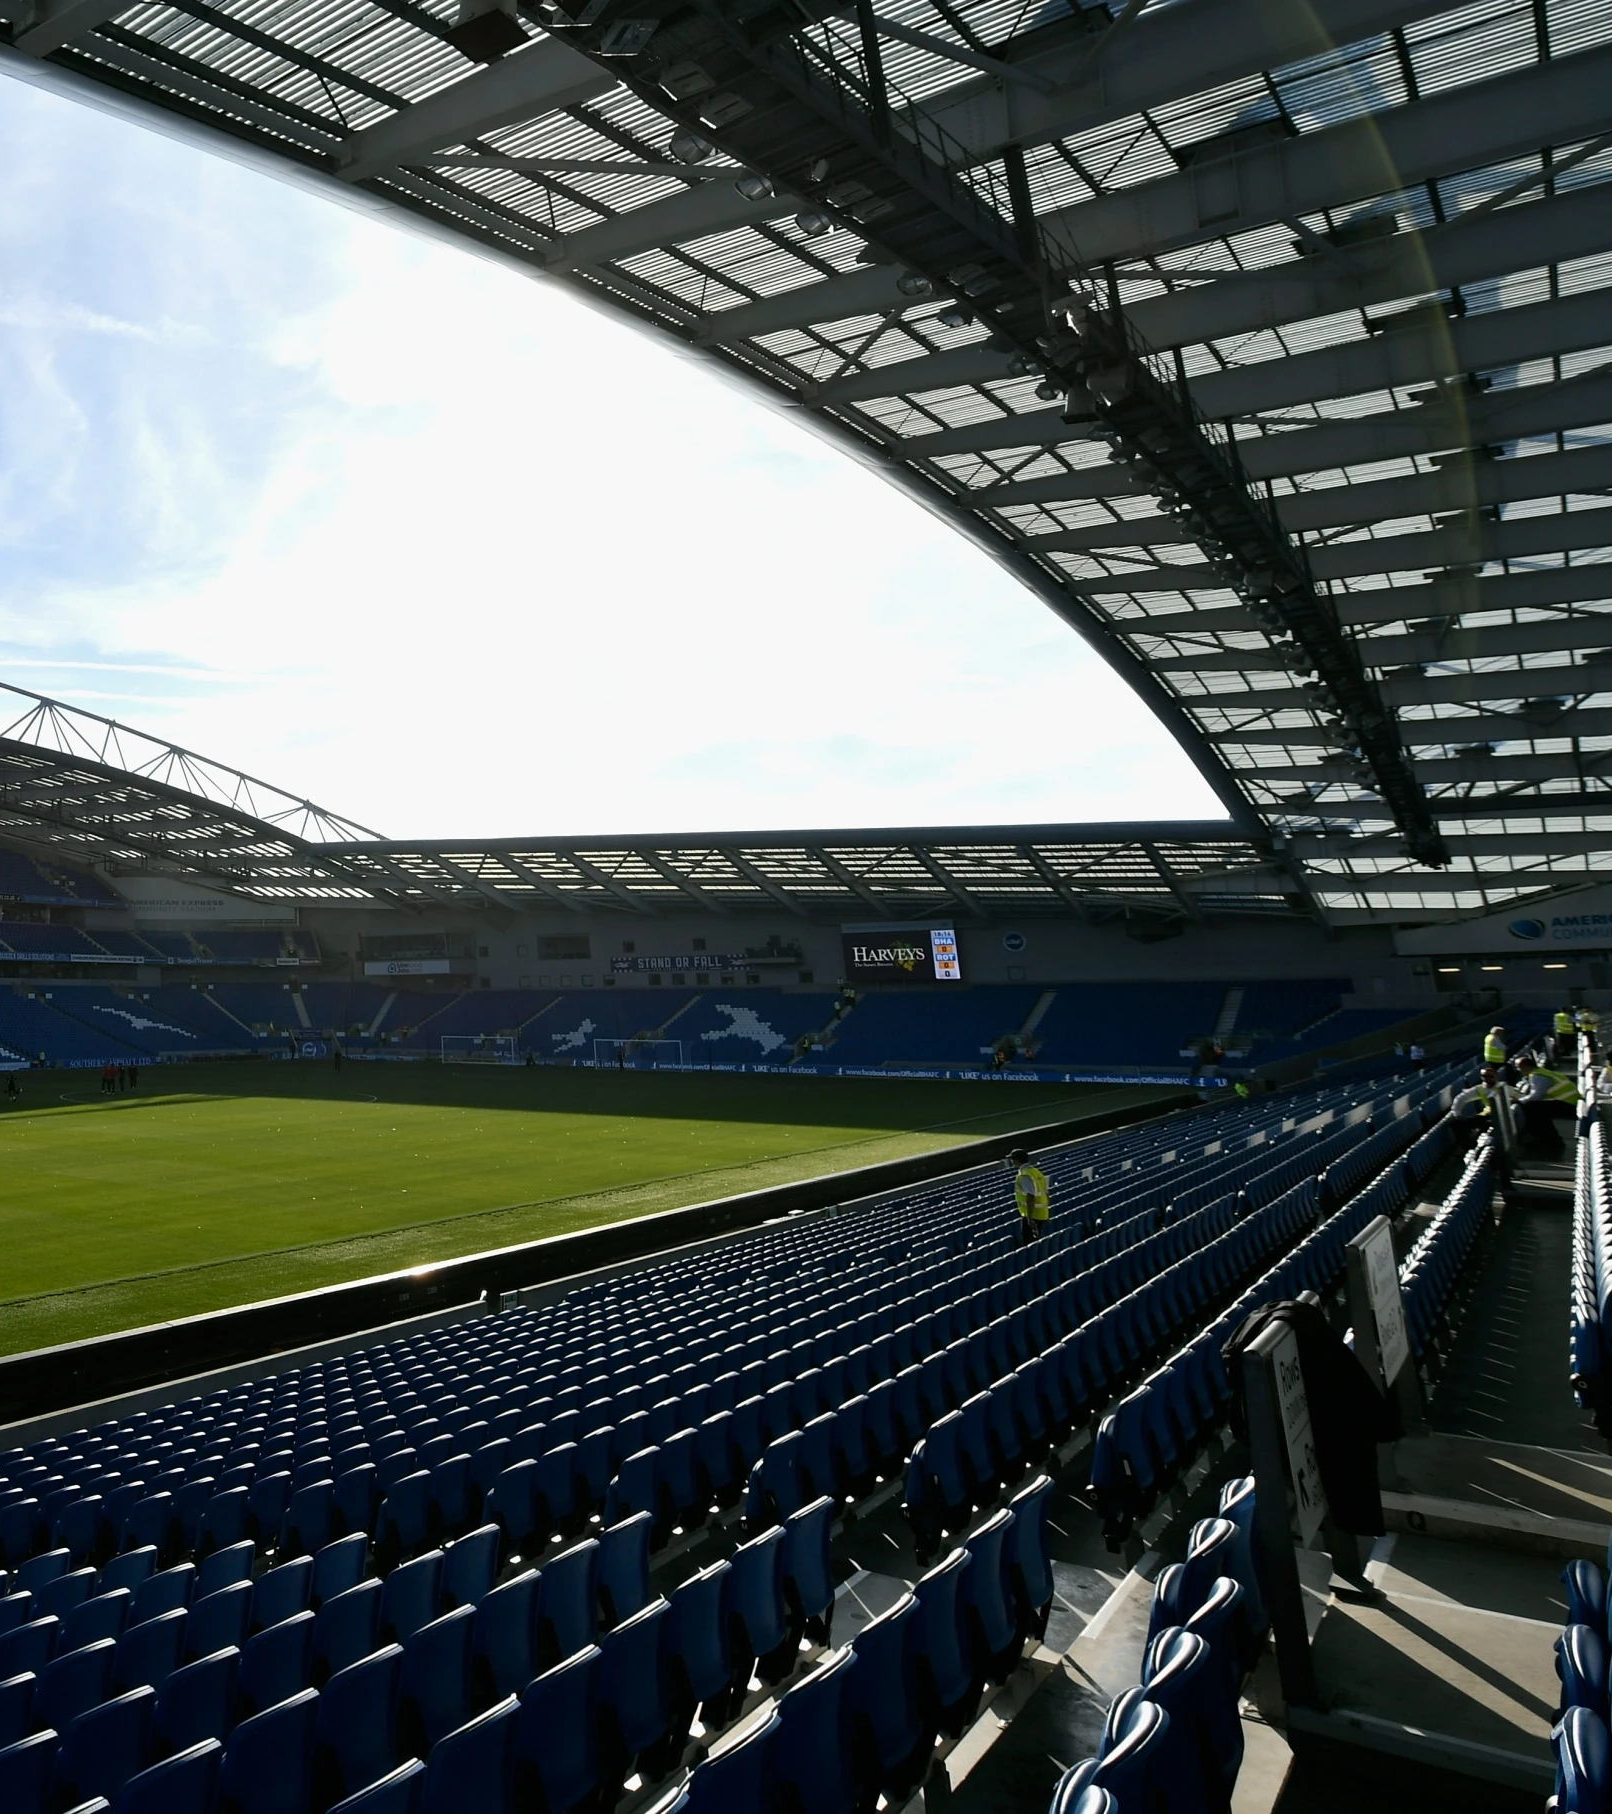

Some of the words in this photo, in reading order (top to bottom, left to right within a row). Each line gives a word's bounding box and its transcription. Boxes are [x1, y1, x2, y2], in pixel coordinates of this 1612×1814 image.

[852, 947, 926, 962] HARVEYS
[637, 957, 671, 968] STAND
[675, 956, 689, 968] OR
[693, 956, 722, 967] FALL
[788, 1066, 818, 1074] Facebook
[959, 1071, 979, 1080] 'LIKE'
[1003, 1072, 1039, 1082] Facebook
[1407, 1510, 1427, 1532] Q
